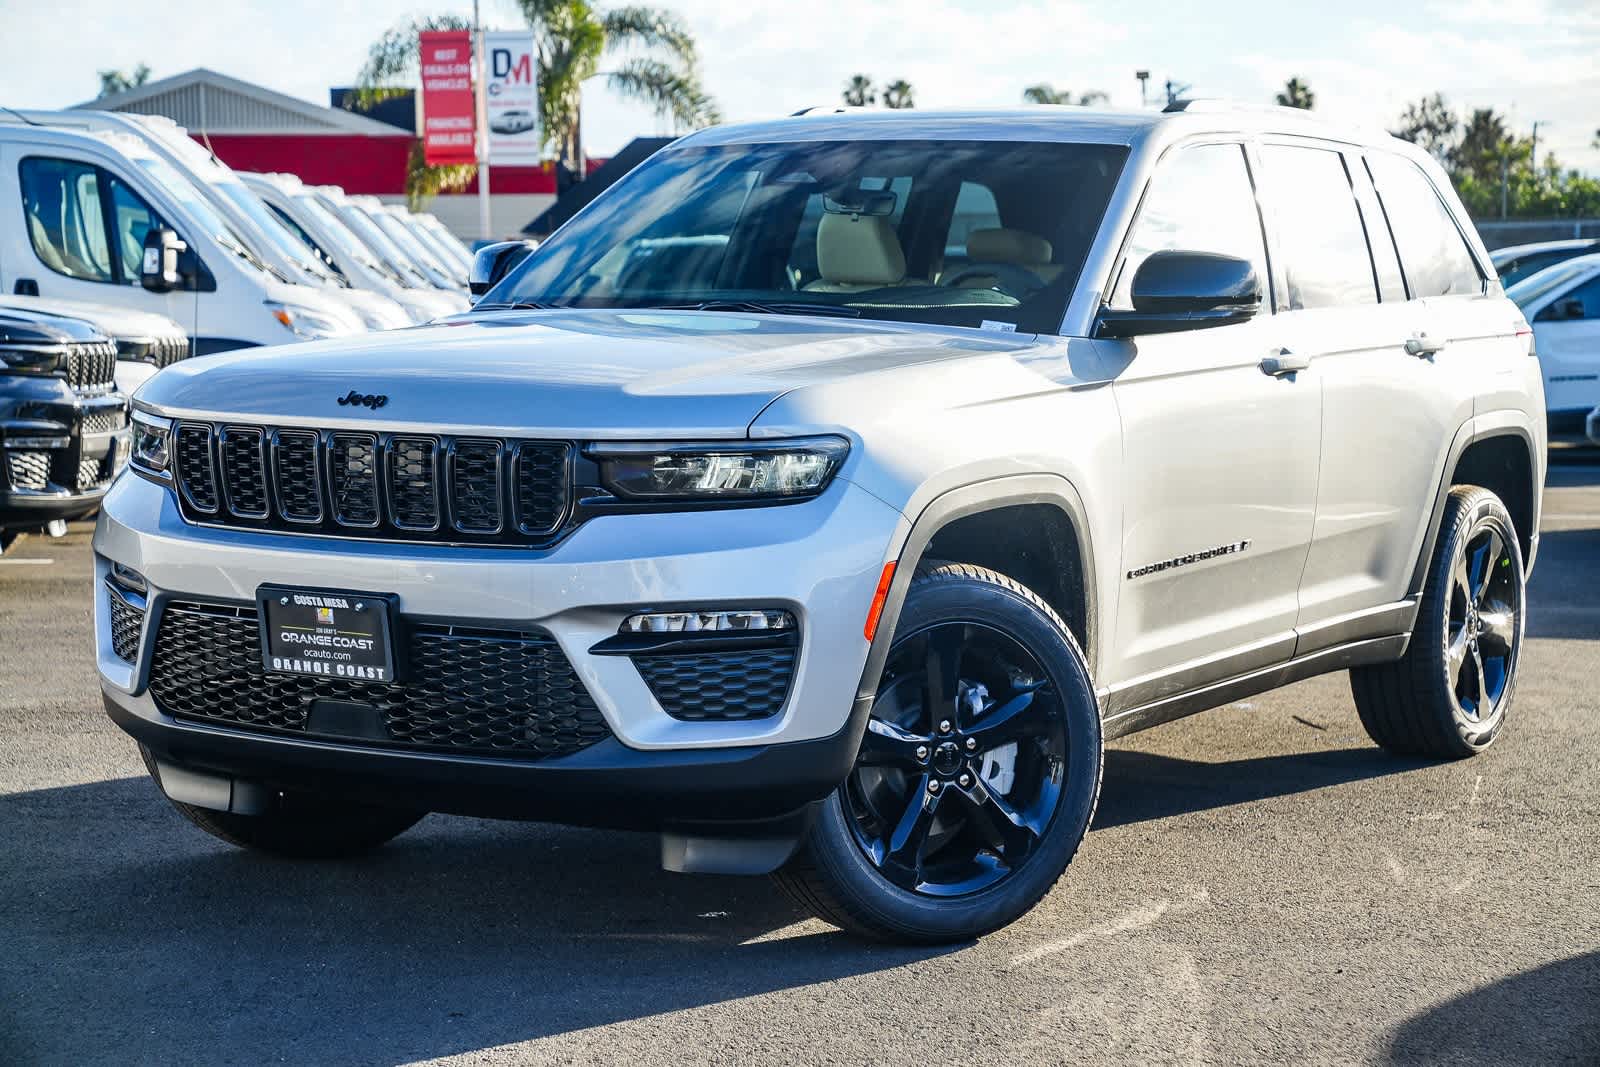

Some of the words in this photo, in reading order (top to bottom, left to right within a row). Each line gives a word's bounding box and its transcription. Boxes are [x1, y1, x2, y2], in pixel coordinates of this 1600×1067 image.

[337, 390, 388, 410] Jeep
[294, 595, 323, 607] COSTA
[323, 597, 349, 609] MESA
[281, 632, 331, 646] ORANGE
[332, 637, 374, 650] COAST
[304, 649, 351, 661] ocauto.com
[273, 657, 330, 675] ORANGE
[336, 663, 384, 680] COAST
